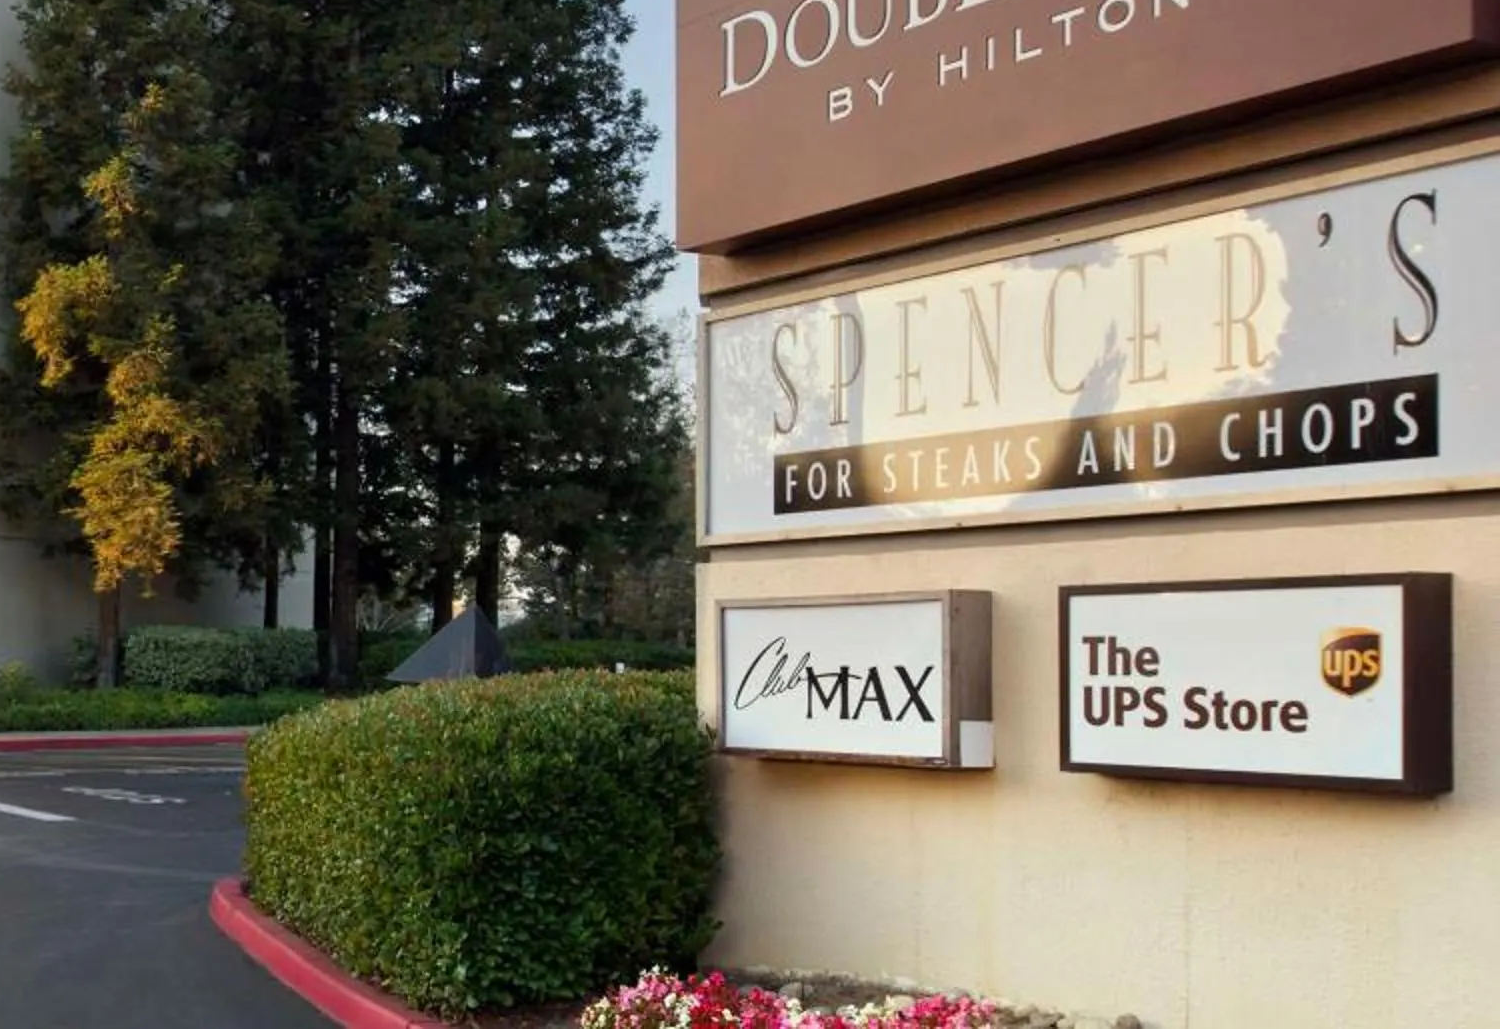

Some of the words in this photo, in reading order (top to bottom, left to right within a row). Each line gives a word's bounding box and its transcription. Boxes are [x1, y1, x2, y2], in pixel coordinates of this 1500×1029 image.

[828, 71, 894, 123] BY
[772, 189, 1439, 437] SPENCER'S
[785, 459, 853, 504] FOR
[883, 436, 1043, 493] STEAKS
[1077, 420, 1178, 476] AND
[1219, 391, 1420, 463] CHOPS
[734, 636, 811, 711] Club
[806, 664, 936, 723] MAX
[1082, 635, 1160, 677] The
[1323, 648, 1381, 688] ups
[1083, 686, 1169, 728] UPS
[1183, 686, 1309, 733] Store
